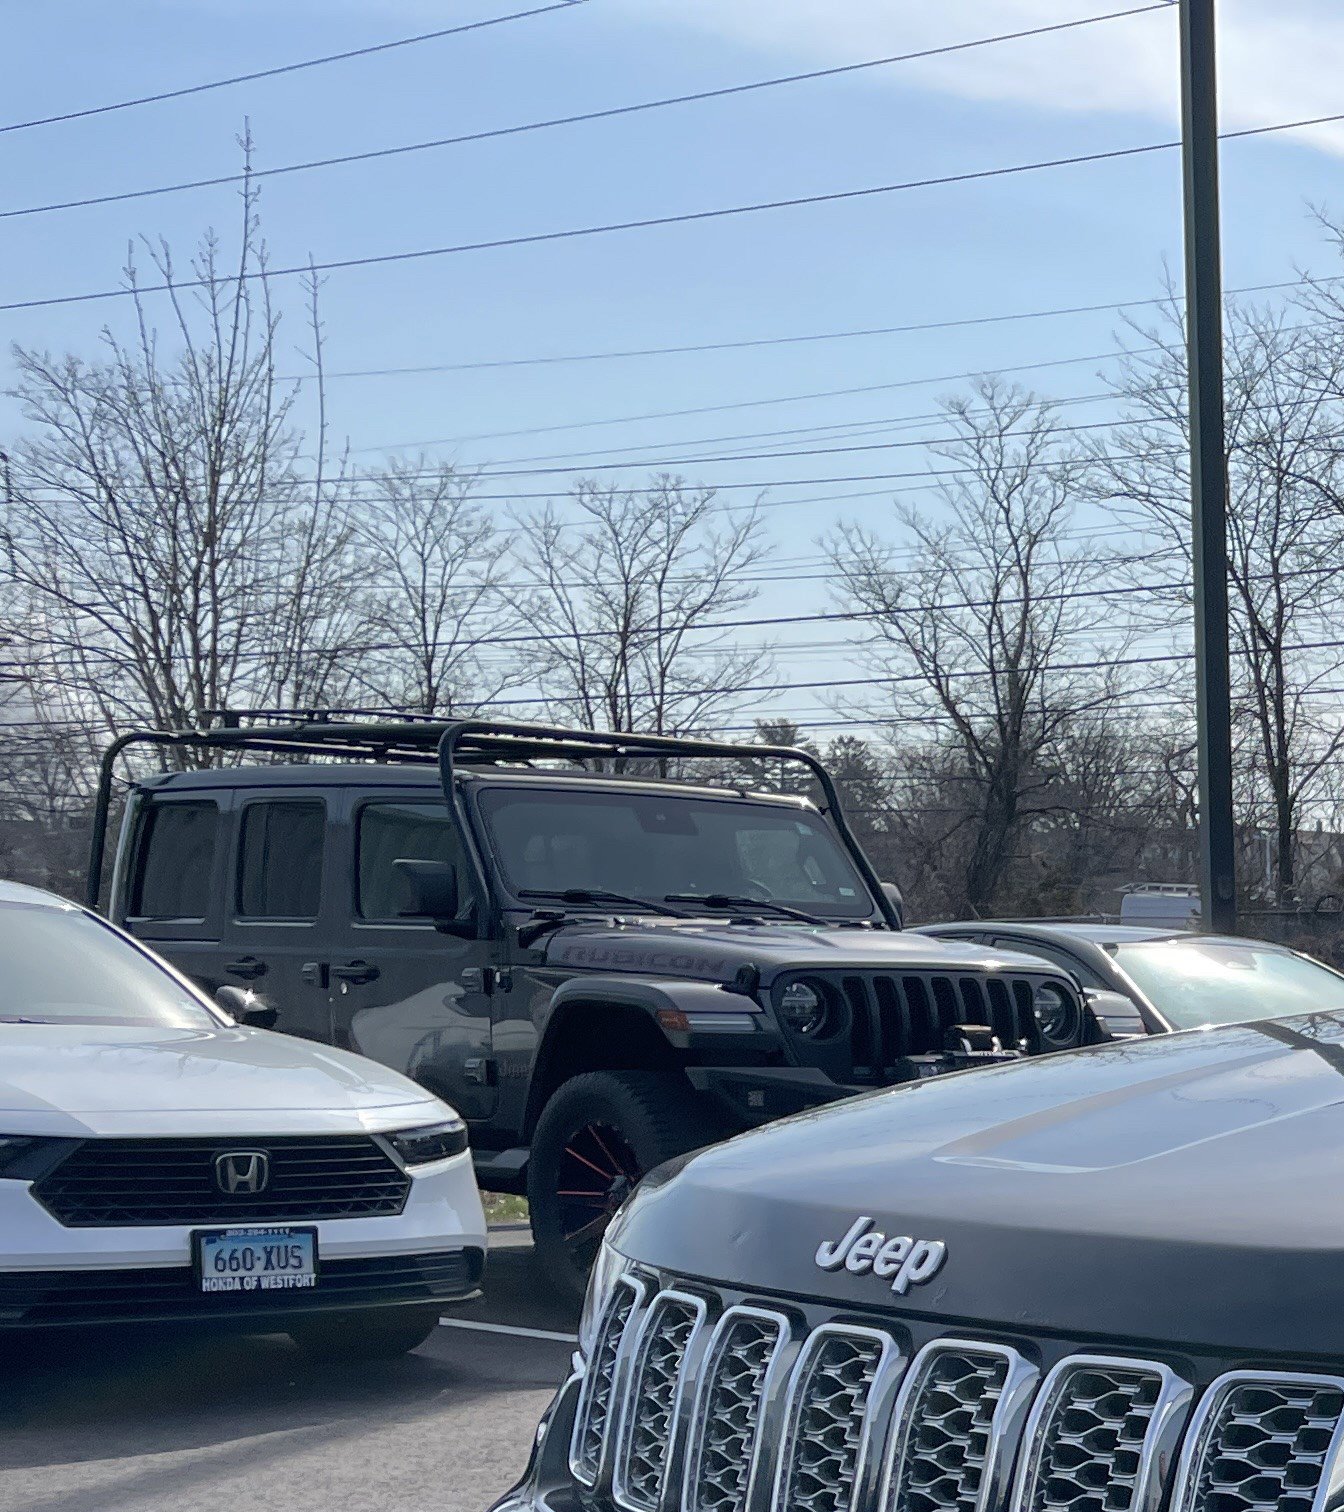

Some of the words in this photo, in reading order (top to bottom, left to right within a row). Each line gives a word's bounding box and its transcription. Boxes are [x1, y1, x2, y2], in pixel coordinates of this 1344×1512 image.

[562, 945, 727, 974] RUBICON
[814, 1215, 948, 1296] Jeep
[202, 1276, 242, 1292] HONDA
[243, 1276, 258, 1291] OF
